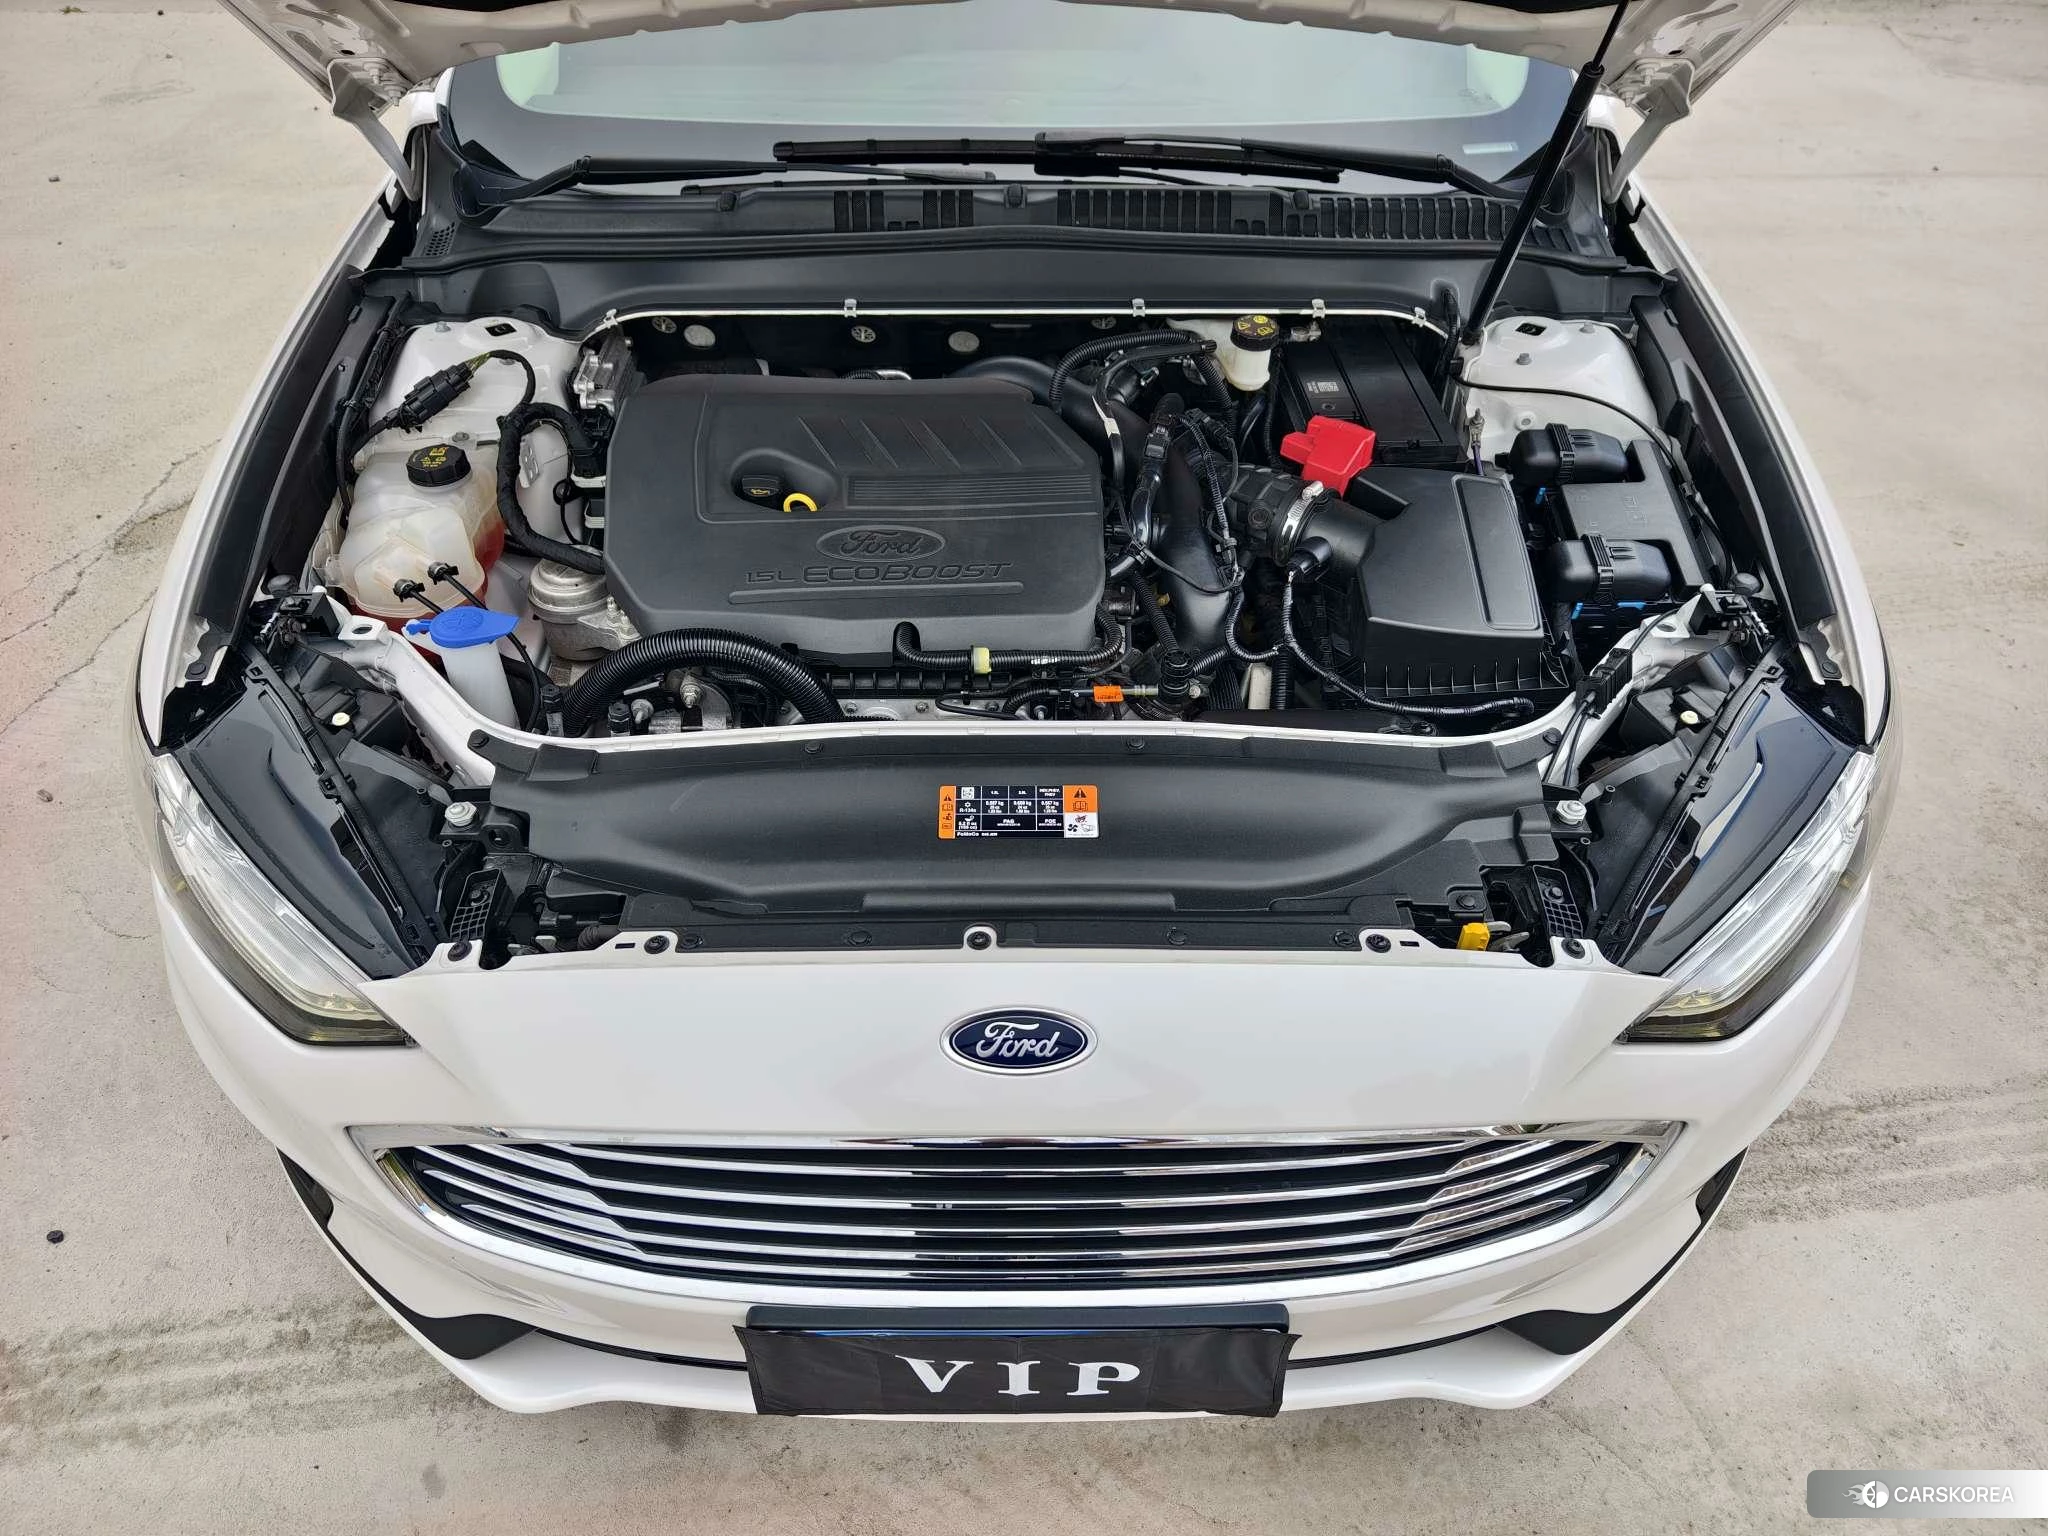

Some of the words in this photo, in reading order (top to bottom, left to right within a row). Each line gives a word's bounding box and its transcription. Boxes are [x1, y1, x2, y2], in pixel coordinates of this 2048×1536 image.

[840, 530, 923, 555] Ford
[802, 562, 1014, 584] ECOBOOST
[975, 1021, 1060, 1058] Ford
[895, 1354, 1140, 1397] VIP
